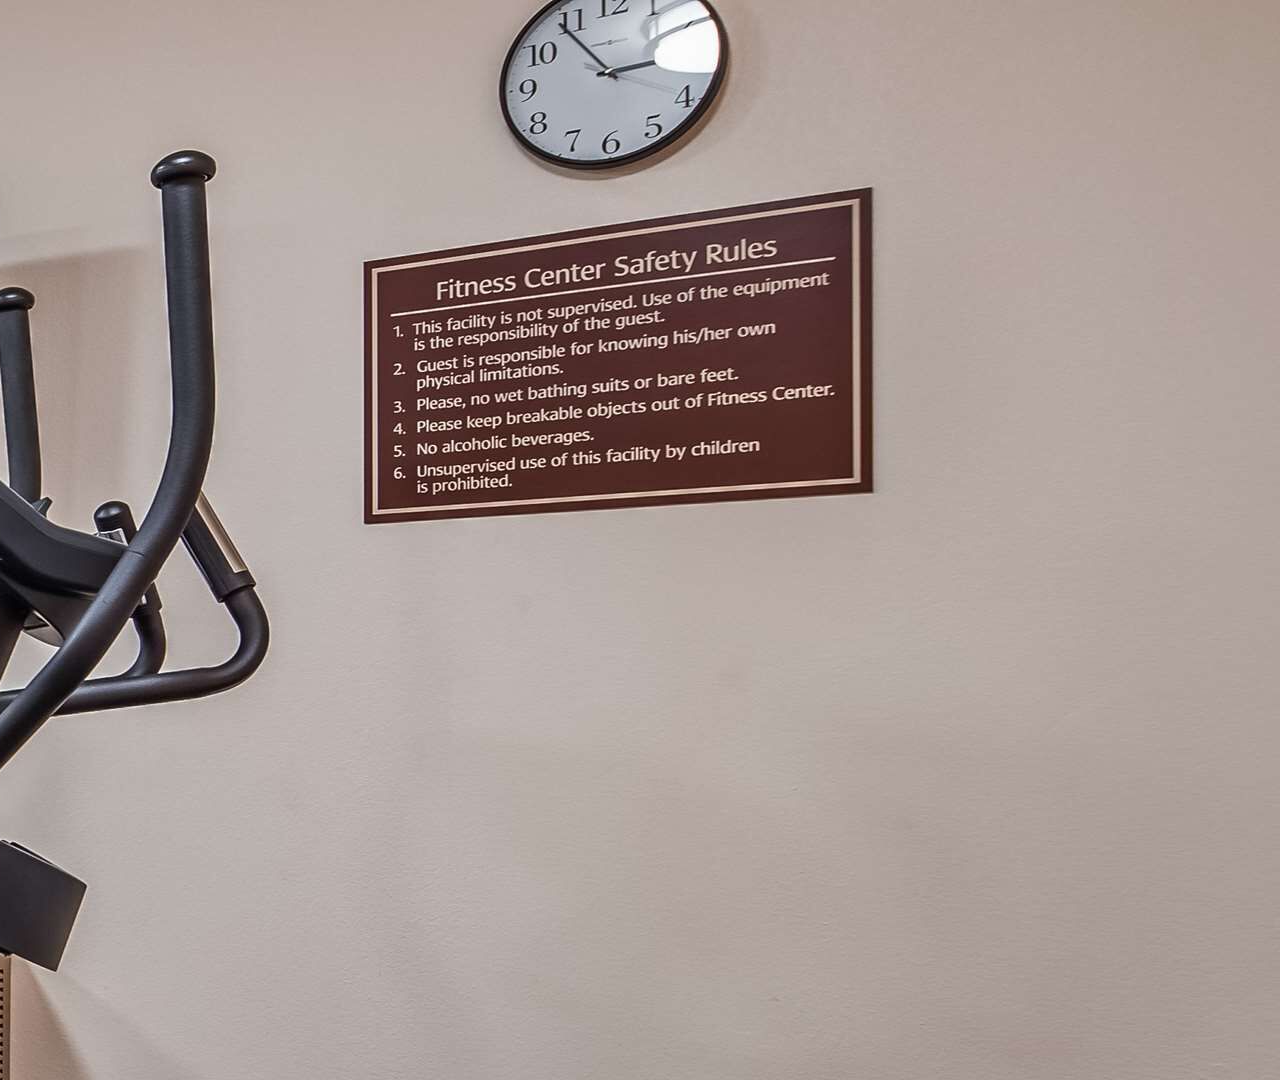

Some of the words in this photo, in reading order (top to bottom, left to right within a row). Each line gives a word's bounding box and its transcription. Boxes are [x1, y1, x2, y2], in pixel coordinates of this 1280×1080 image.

[558, 9, 587, 35] 11
[522, 41, 558, 67] 10
[519, 79, 538, 103] 9
[674, 84, 694, 109] 4
[530, 112, 547, 134] 8
[645, 114, 662, 138] 5
[564, 129, 581, 152] 7
[602, 130, 620, 154] 6
[436, 275, 516, 300] Fitness
[524, 262, 606, 288] Center
[614, 251, 697, 276] Safety
[706, 239, 778, 264] Rules
[393, 326, 404, 337] 1.
[413, 321, 442, 335] This
[447, 313, 496, 332] facility
[501, 311, 512, 323] is
[517, 308, 543, 322] not
[547, 295, 638, 319] supervised.
[642, 292, 672, 307] Use
[677, 288, 695, 302] of
[700, 285, 728, 300] the
[733, 272, 830, 297] equipment
[414, 338, 425, 351] is
[430, 335, 454, 349] the
[458, 323, 558, 346] responsibility
[562, 318, 580, 333] of
[584, 315, 610, 331] the
[615, 310, 665, 330] guest.
[393, 363, 406, 376] 2.
[417, 357, 458, 372] Guest
[463, 355, 475, 367] is
[479, 343, 566, 367] responsible
[571, 341, 594, 356] for
[598, 331, 668, 354] knowing
[673, 326, 732, 345] his/her
[737, 323, 776, 337] own
[417, 368, 474, 392] physical
[480, 361, 564, 380] limitations.
[393, 401, 406, 413] 3.
[417, 394, 467, 412] Please,
[471, 394, 490, 406] no
[495, 389, 524, 403] wet
[528, 382, 587, 400] bathing
[592, 377, 630, 394] suits
[634, 376, 653, 389] or
[657, 373, 695, 387] bare
[700, 368, 739, 383] feet.
[393, 423, 406, 435] 4.
[417, 416, 462, 434] Please
[467, 413, 502, 429] keep
[506, 405, 583, 425] breakable
[587, 399, 646, 419] objects
[651, 397, 680, 412] out
[685, 393, 703, 409] of
[708, 390, 768, 407] Fitness
[772, 384, 835, 401] Center.
[393, 445, 406, 457] 5.
[417, 442, 437, 456] No
[442, 435, 507, 454] alcoholic
[512, 429, 595, 449] beverages.
[393, 467, 406, 480] 6.
[417, 457, 516, 479] Unsupervised
[521, 455, 546, 470] use
[551, 452, 568, 467] of
[572, 449, 601, 466] this
[607, 446, 661, 463] facility
[666, 444, 687, 461] by
[691, 439, 760, 457] children
[417, 480, 428, 494] is
[432, 473, 512, 495] prohibited.
